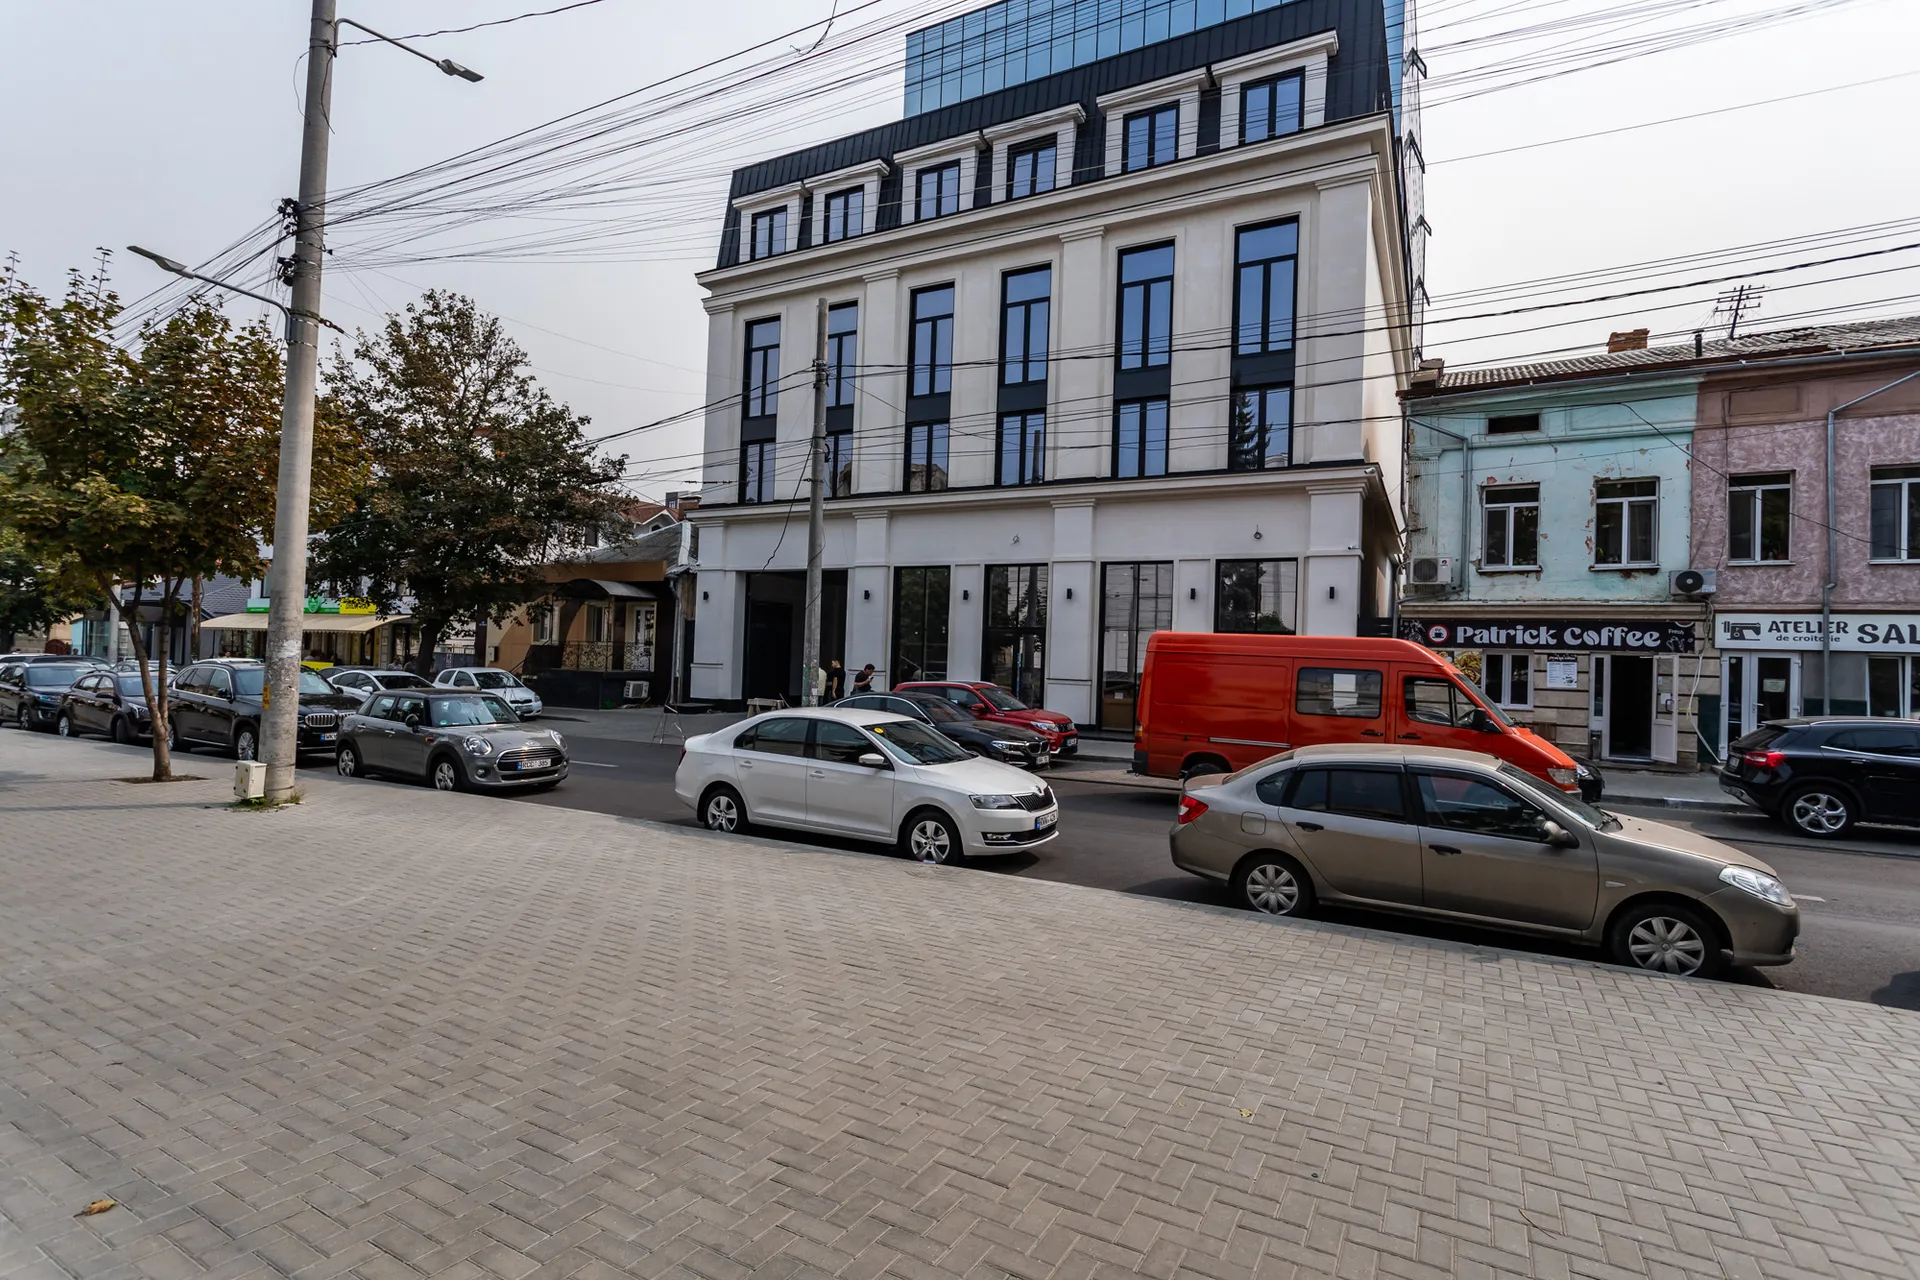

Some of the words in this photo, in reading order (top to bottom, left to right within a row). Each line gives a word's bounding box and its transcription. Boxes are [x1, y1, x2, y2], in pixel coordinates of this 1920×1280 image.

[1668, 628, 1685, 636] Fresh
[1767, 620, 1849, 634] ATELIER
[1456, 625, 1557, 645] Patrick
[1563, 626, 1661, 647] Coffee
[1775, 634, 1790, 642] de
[1792, 635, 1841, 643] croitoie
